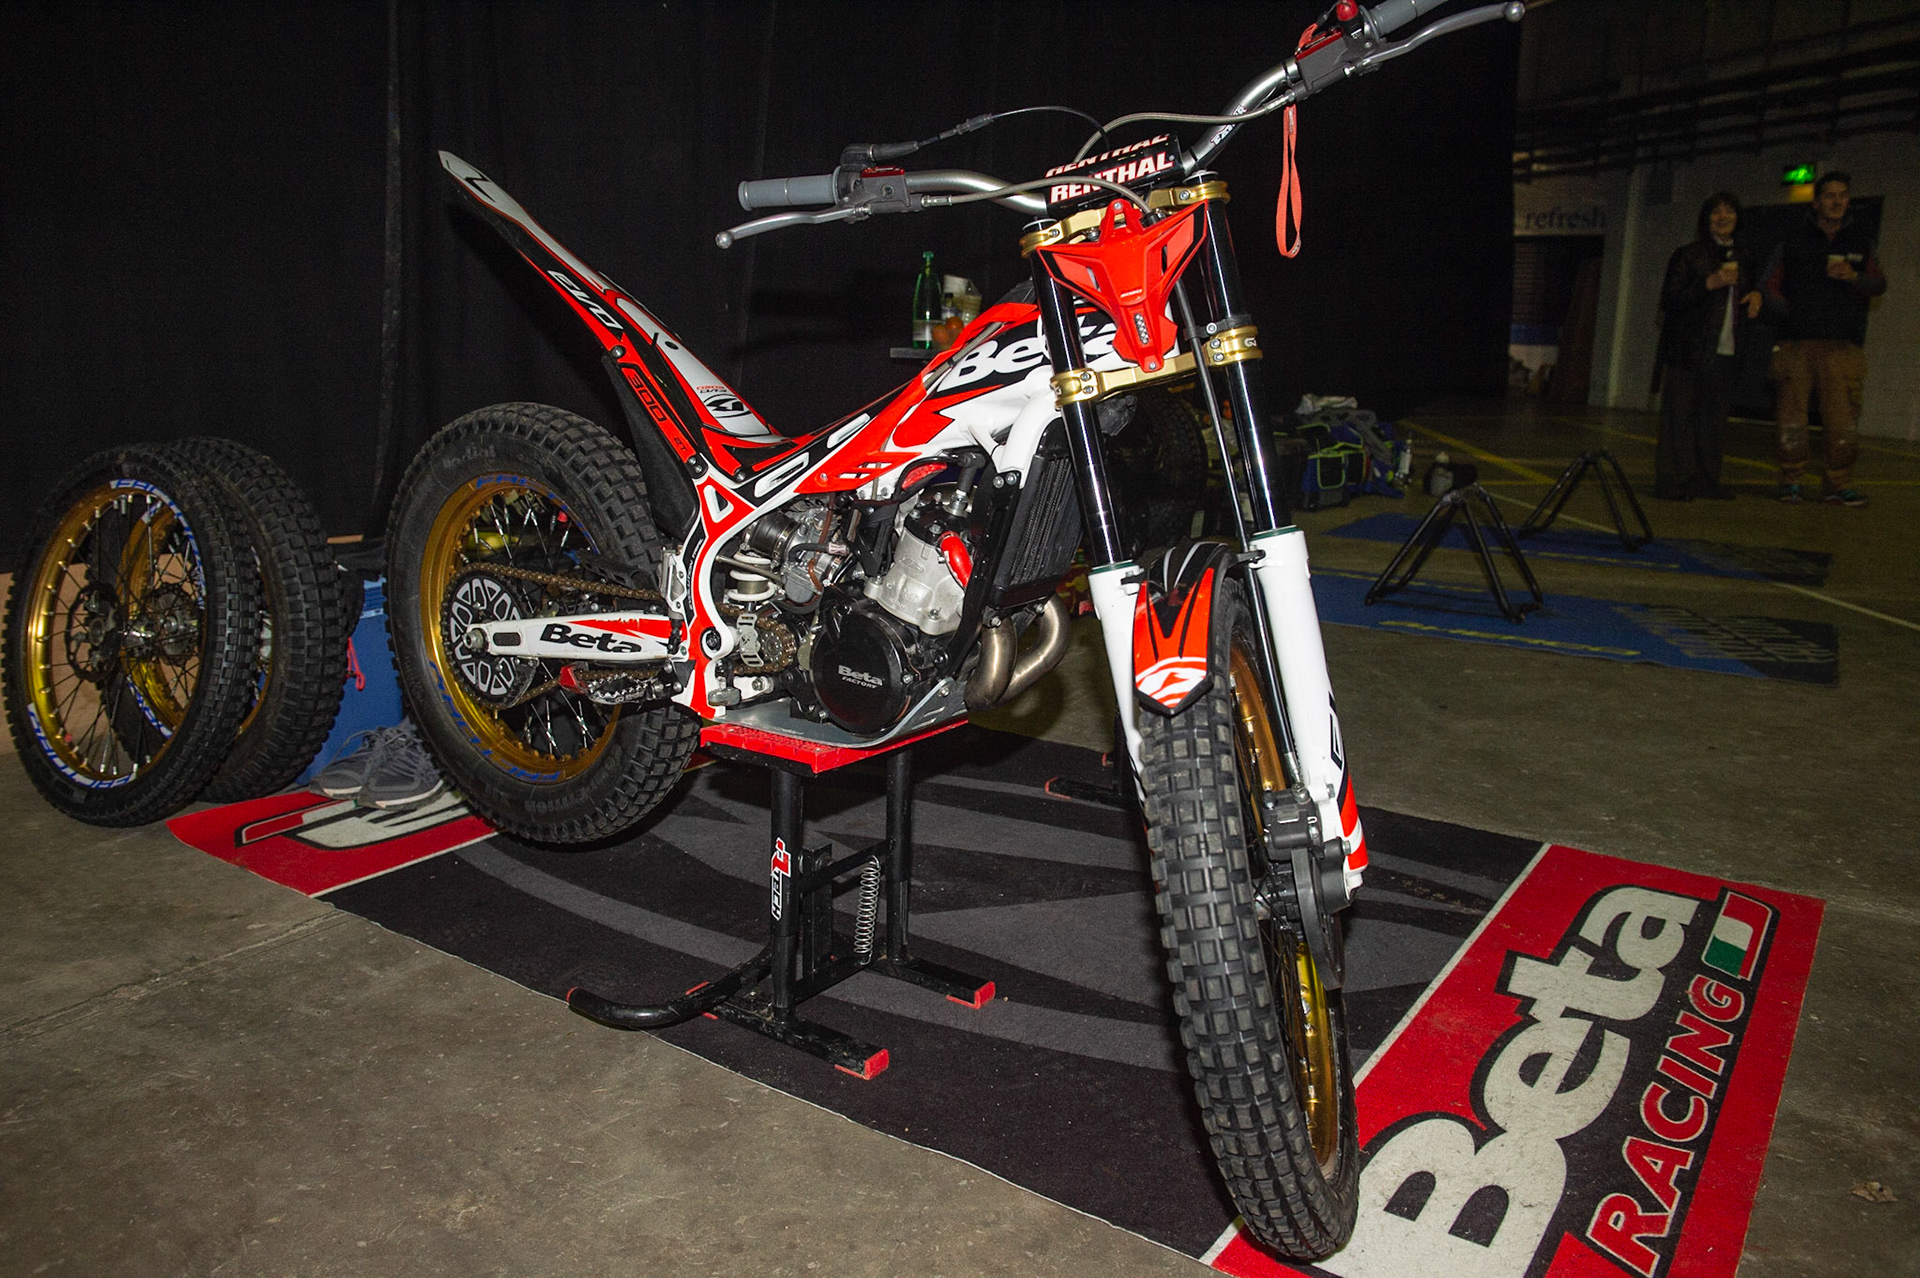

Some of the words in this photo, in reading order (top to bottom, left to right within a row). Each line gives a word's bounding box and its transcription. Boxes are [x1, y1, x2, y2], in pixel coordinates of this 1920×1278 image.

[1050, 151, 1174, 204] RENTHAL
[1524, 206, 1606, 230] refresh
[547, 270, 624, 330] EVO
[627, 374, 667, 422] 300
[539, 623, 642, 653] Beta
[838, 664, 883, 686] Beta
[841, 676, 878, 689] FACTORY
[1318, 886, 1701, 1278] Beta
[1586, 974, 1746, 1278] RACING
